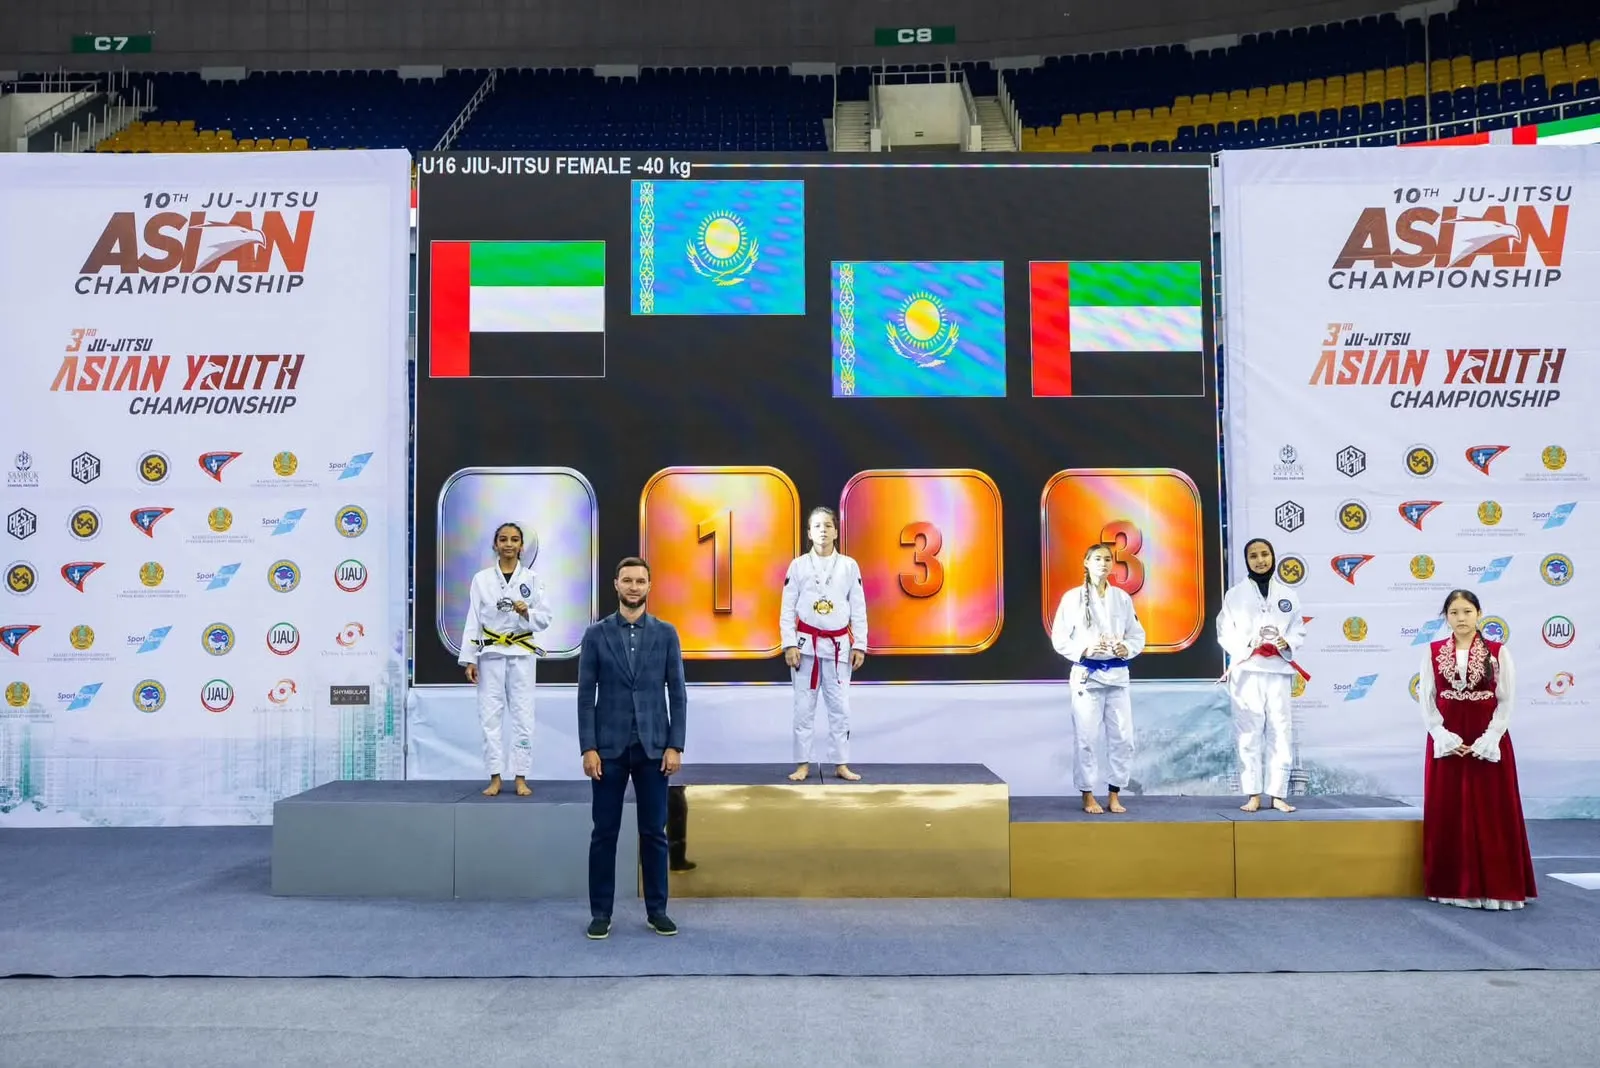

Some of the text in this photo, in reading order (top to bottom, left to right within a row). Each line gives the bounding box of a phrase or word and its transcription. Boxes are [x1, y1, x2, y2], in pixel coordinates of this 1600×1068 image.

[897, 28, 932, 43] C8
[94, 36, 129, 51] C7
[421, 156, 691, 178] U16 JIU-JITSU FEMALE -40 kg
[200, 191, 319, 209] JU-JITSU
[1452, 186, 1573, 204] JU-JITSU
[79, 210, 315, 274] ASIAN
[1331, 204, 1570, 270] ASIAN
[74, 274, 305, 295] CHAMPIONSHIP
[1327, 269, 1562, 290] CHAMPIONSHIP
[86, 338, 154, 352] JU-JITSU
[1344, 332, 1411, 347] JU-JITSU
[49, 353, 306, 393] ASIAN YOUTH
[1308, 348, 1567, 388] ASIAN YOUTH
[128, 395, 297, 415] CHAMPIONSHIP
[1389, 389, 1561, 409] CHAMPIONSHIP
[329, 462, 347, 470] Sport
[262, 517, 280, 525] Sport
[1532, 511, 1551, 519] Sport
[697, 510, 733, 614] 1
[898, 521, 945, 598] 3
[1100, 519, 1146, 595] 3
[196, 572, 215, 580] Sport
[340, 567, 363, 581] JJAU
[1468, 565, 1486, 573] Sport
[272, 630, 295, 644] JJAU
[1400, 627, 1419, 635] Sport
[1547, 623, 1570, 637] JJAU
[127, 635, 146, 643] Sport
[206, 687, 229, 701] JJAU
[1333, 683, 1352, 691] Sport
[57, 692, 76, 700] Sport
